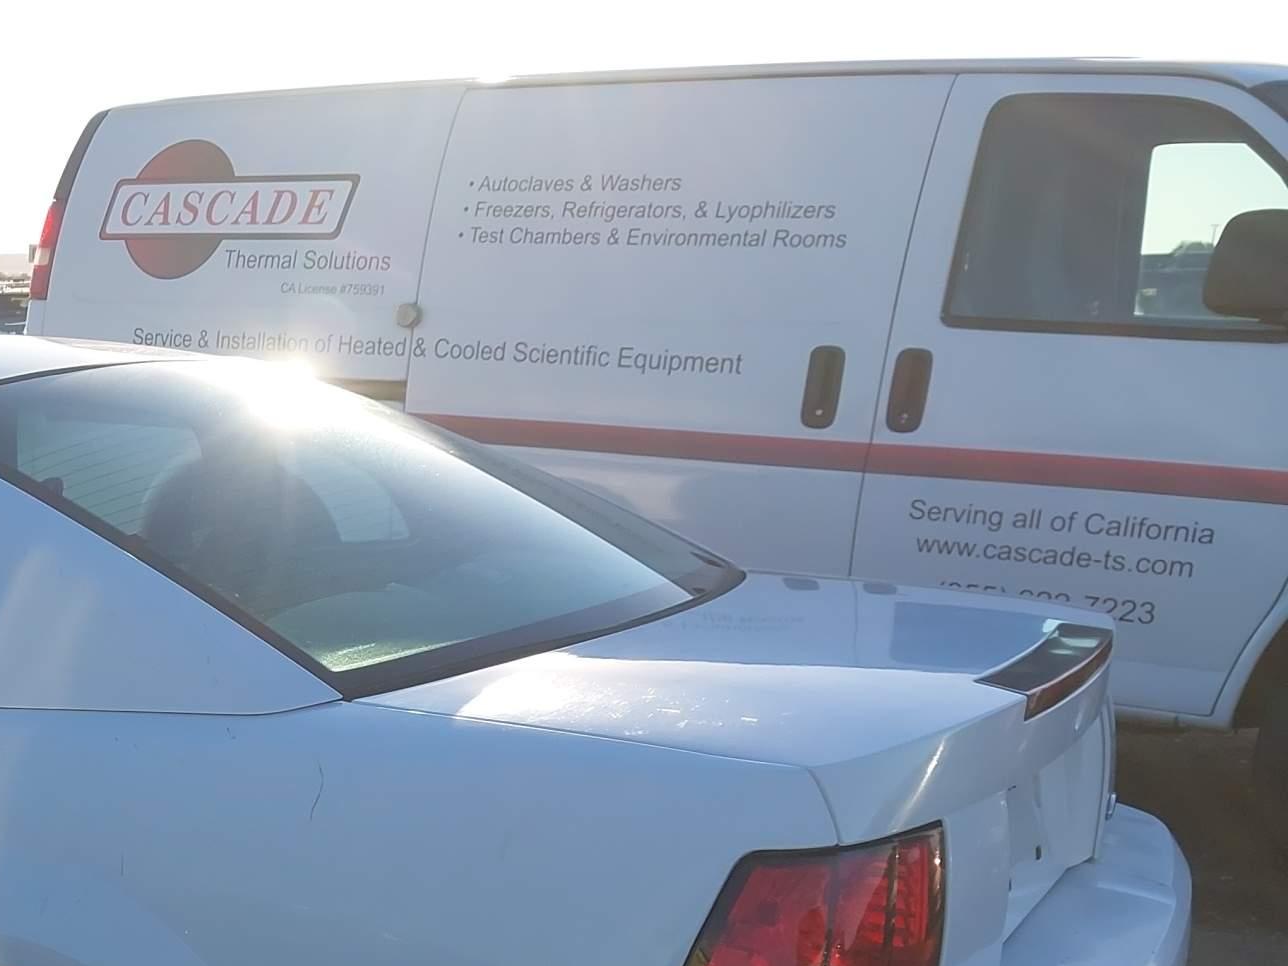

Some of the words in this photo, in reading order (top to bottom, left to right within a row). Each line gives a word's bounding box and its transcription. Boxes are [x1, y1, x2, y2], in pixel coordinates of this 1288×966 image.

[478, 174, 574, 193] Autoclaves
[580, 175, 593, 192] &
[600, 174, 682, 193] Washers
[120, 188, 336, 227] CASCADE
[474, 201, 556, 221] Freezers,
[562, 201, 687, 223] Refrigerators,
[694, 201, 709, 219] &
[715, 201, 836, 223] Lyophilizers
[471, 227, 505, 245] Test
[509, 227, 601, 246] Chambers
[607, 228, 621, 246] &
[626, 228, 767, 248] Environmental
[772, 229, 848, 249] Rooms
[224, 249, 297, 271] Thermal
[303, 250, 392, 272] Solutions
[280, 282, 296, 294] CA
[298, 283, 338, 295] License
[133, 328, 192, 349] Service
[198, 330, 209, 348] &
[216, 330, 309, 352] Installation
[338, 335, 406, 357] Heated
[413, 338, 426, 357] &
[435, 338, 506, 362] Cooled
[513, 342, 611, 368] Scientific
[617, 347, 743, 376] Equipment
[909, 498, 1005, 532] Serving
[1011, 509, 1042, 531] all
[1050, 511, 1078, 533] of
[1084, 512, 1216, 545] California
[916, 534, 1194, 578] www.cascade-ts.com
